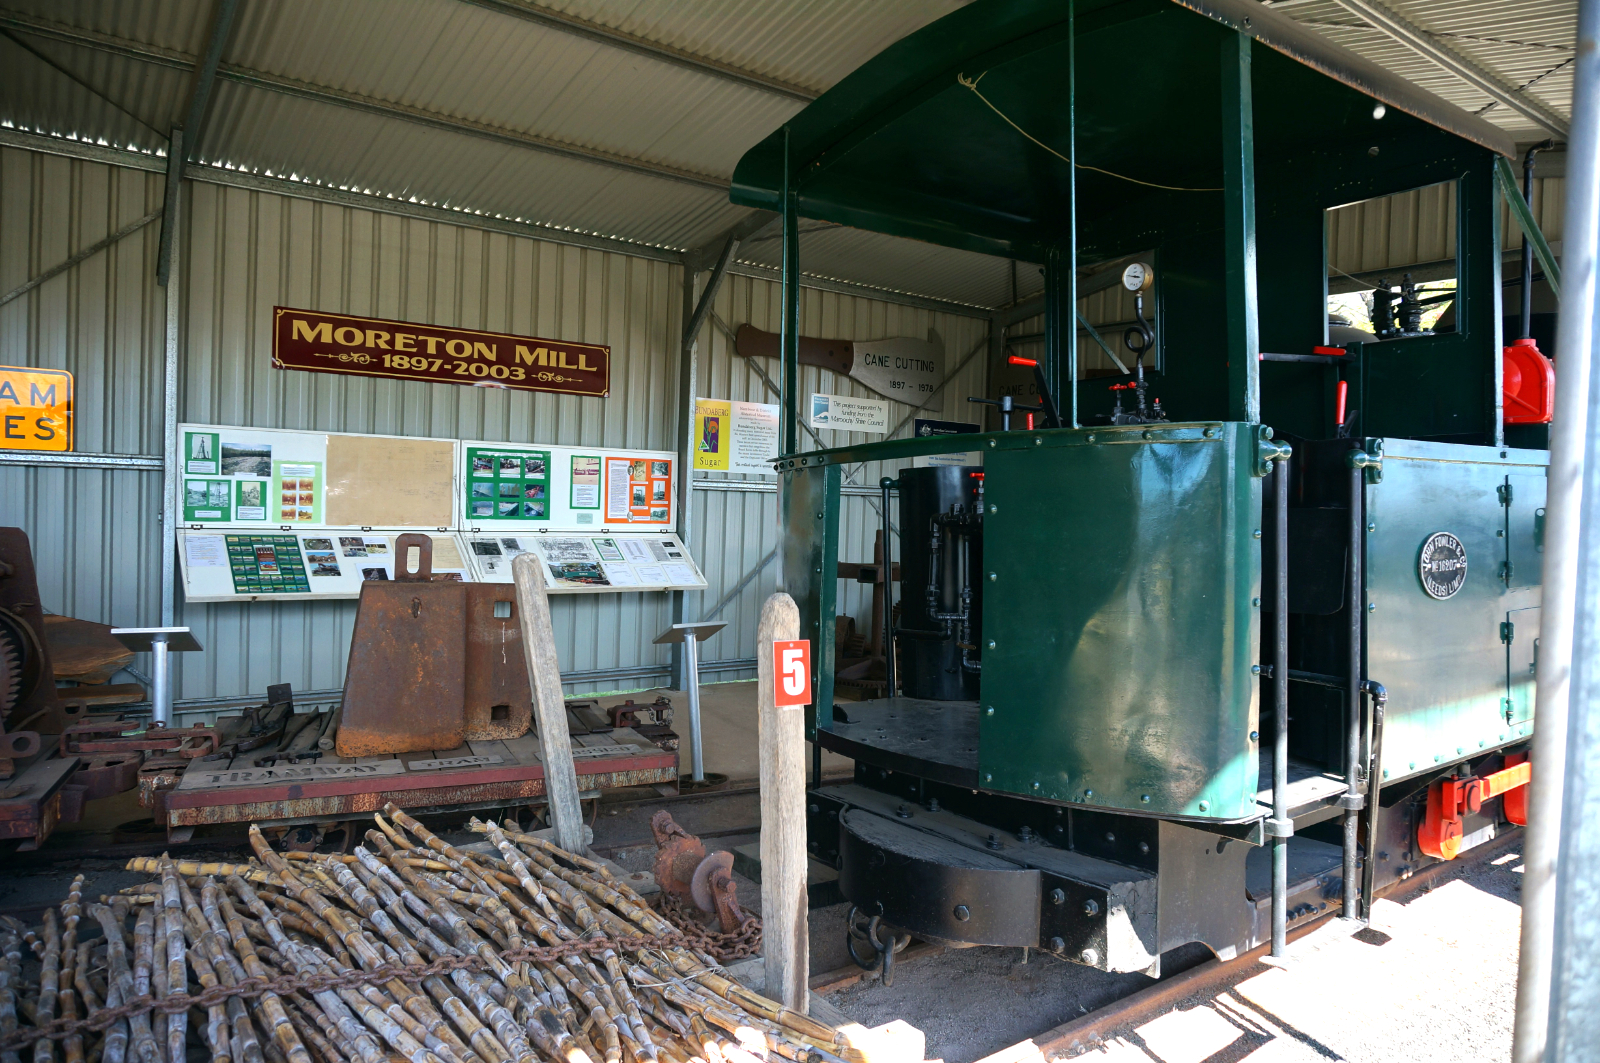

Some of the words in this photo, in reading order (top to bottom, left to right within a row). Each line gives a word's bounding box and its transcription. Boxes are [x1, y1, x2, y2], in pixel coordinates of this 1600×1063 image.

[291, 318, 497, 362] MORETON
[514, 344, 598, 373] MILL
[382, 353, 526, 381] 1897-2003
[864, 353, 890, 368] CANE
[895, 357, 935, 373] CUTTING
[889, 380, 906, 390] 1897
[918, 383, 934, 393] 1978
[695, 405, 729, 416] BUNDABERG
[5, 415, 56, 440] ES
[700, 456, 721, 467] Sugar
[1435, 535, 1457, 550] FOWLER
[1439, 559, 1458, 572] 16207
[782, 649, 806, 697] 5
[420, 757, 490, 768] TRAM
[206, 764, 383, 783] TRAMWAY
